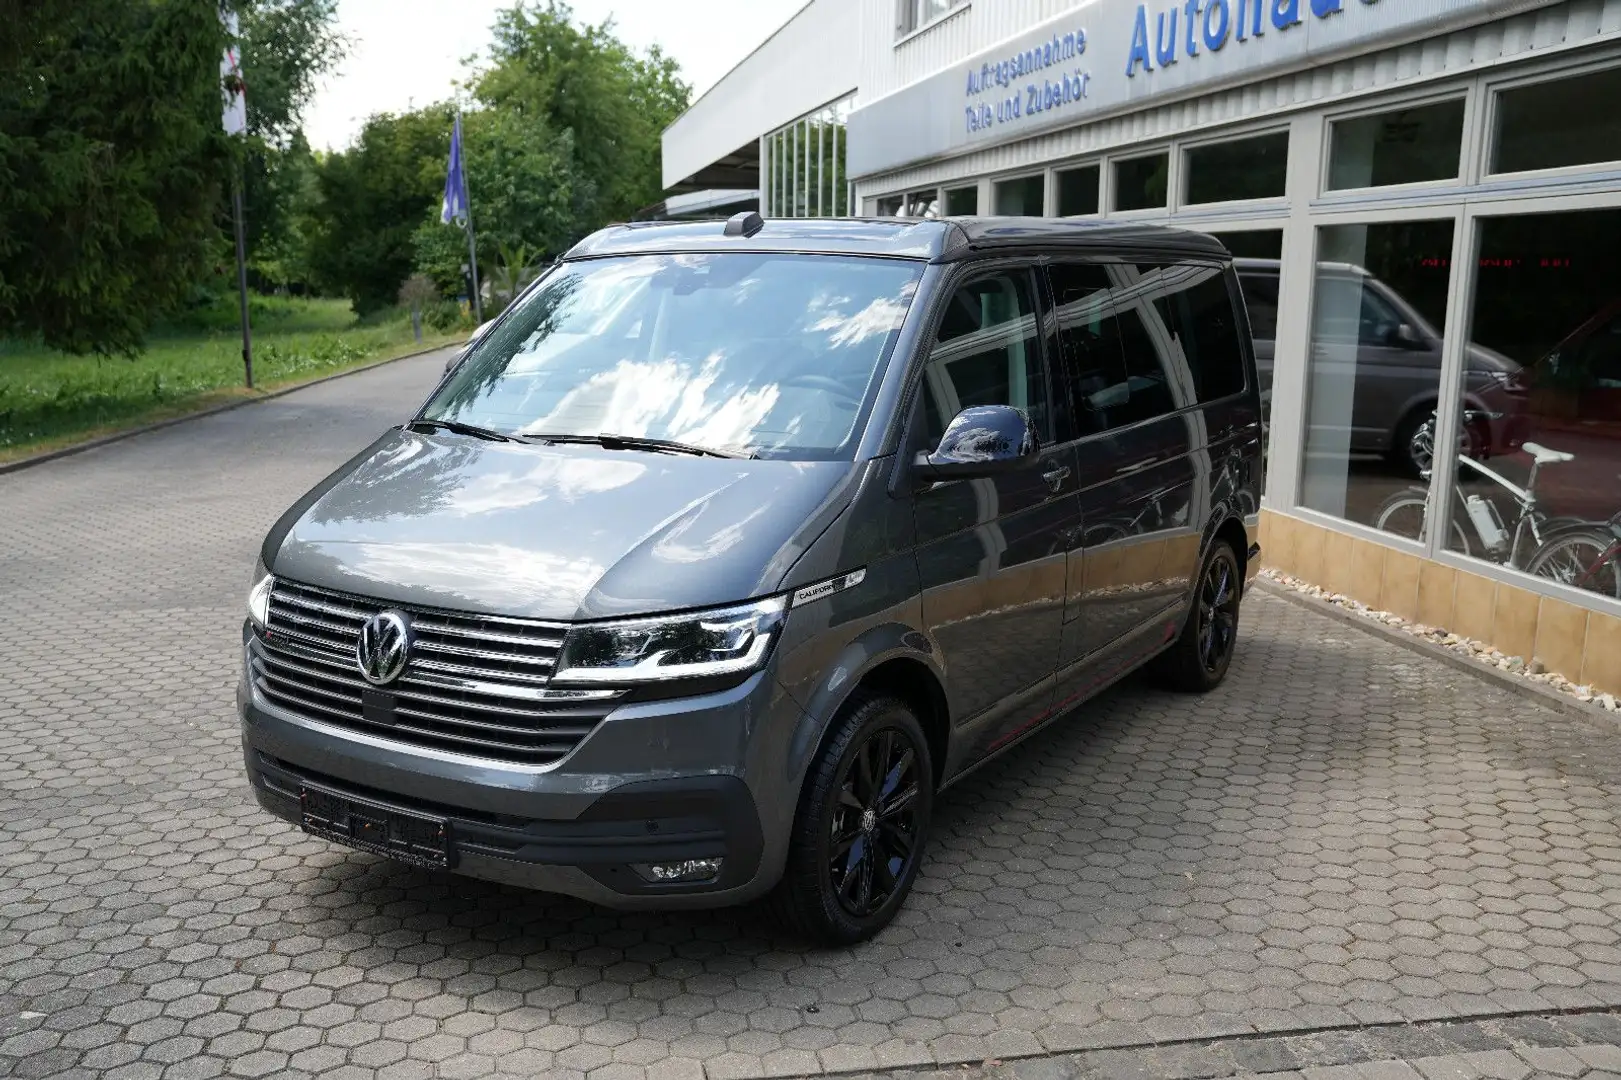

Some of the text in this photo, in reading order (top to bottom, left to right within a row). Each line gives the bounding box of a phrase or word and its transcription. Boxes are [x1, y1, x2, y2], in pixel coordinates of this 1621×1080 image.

[965, 28, 1087, 97] Auftragsannahme
[965, 68, 1090, 133] Teile und Zubehör
